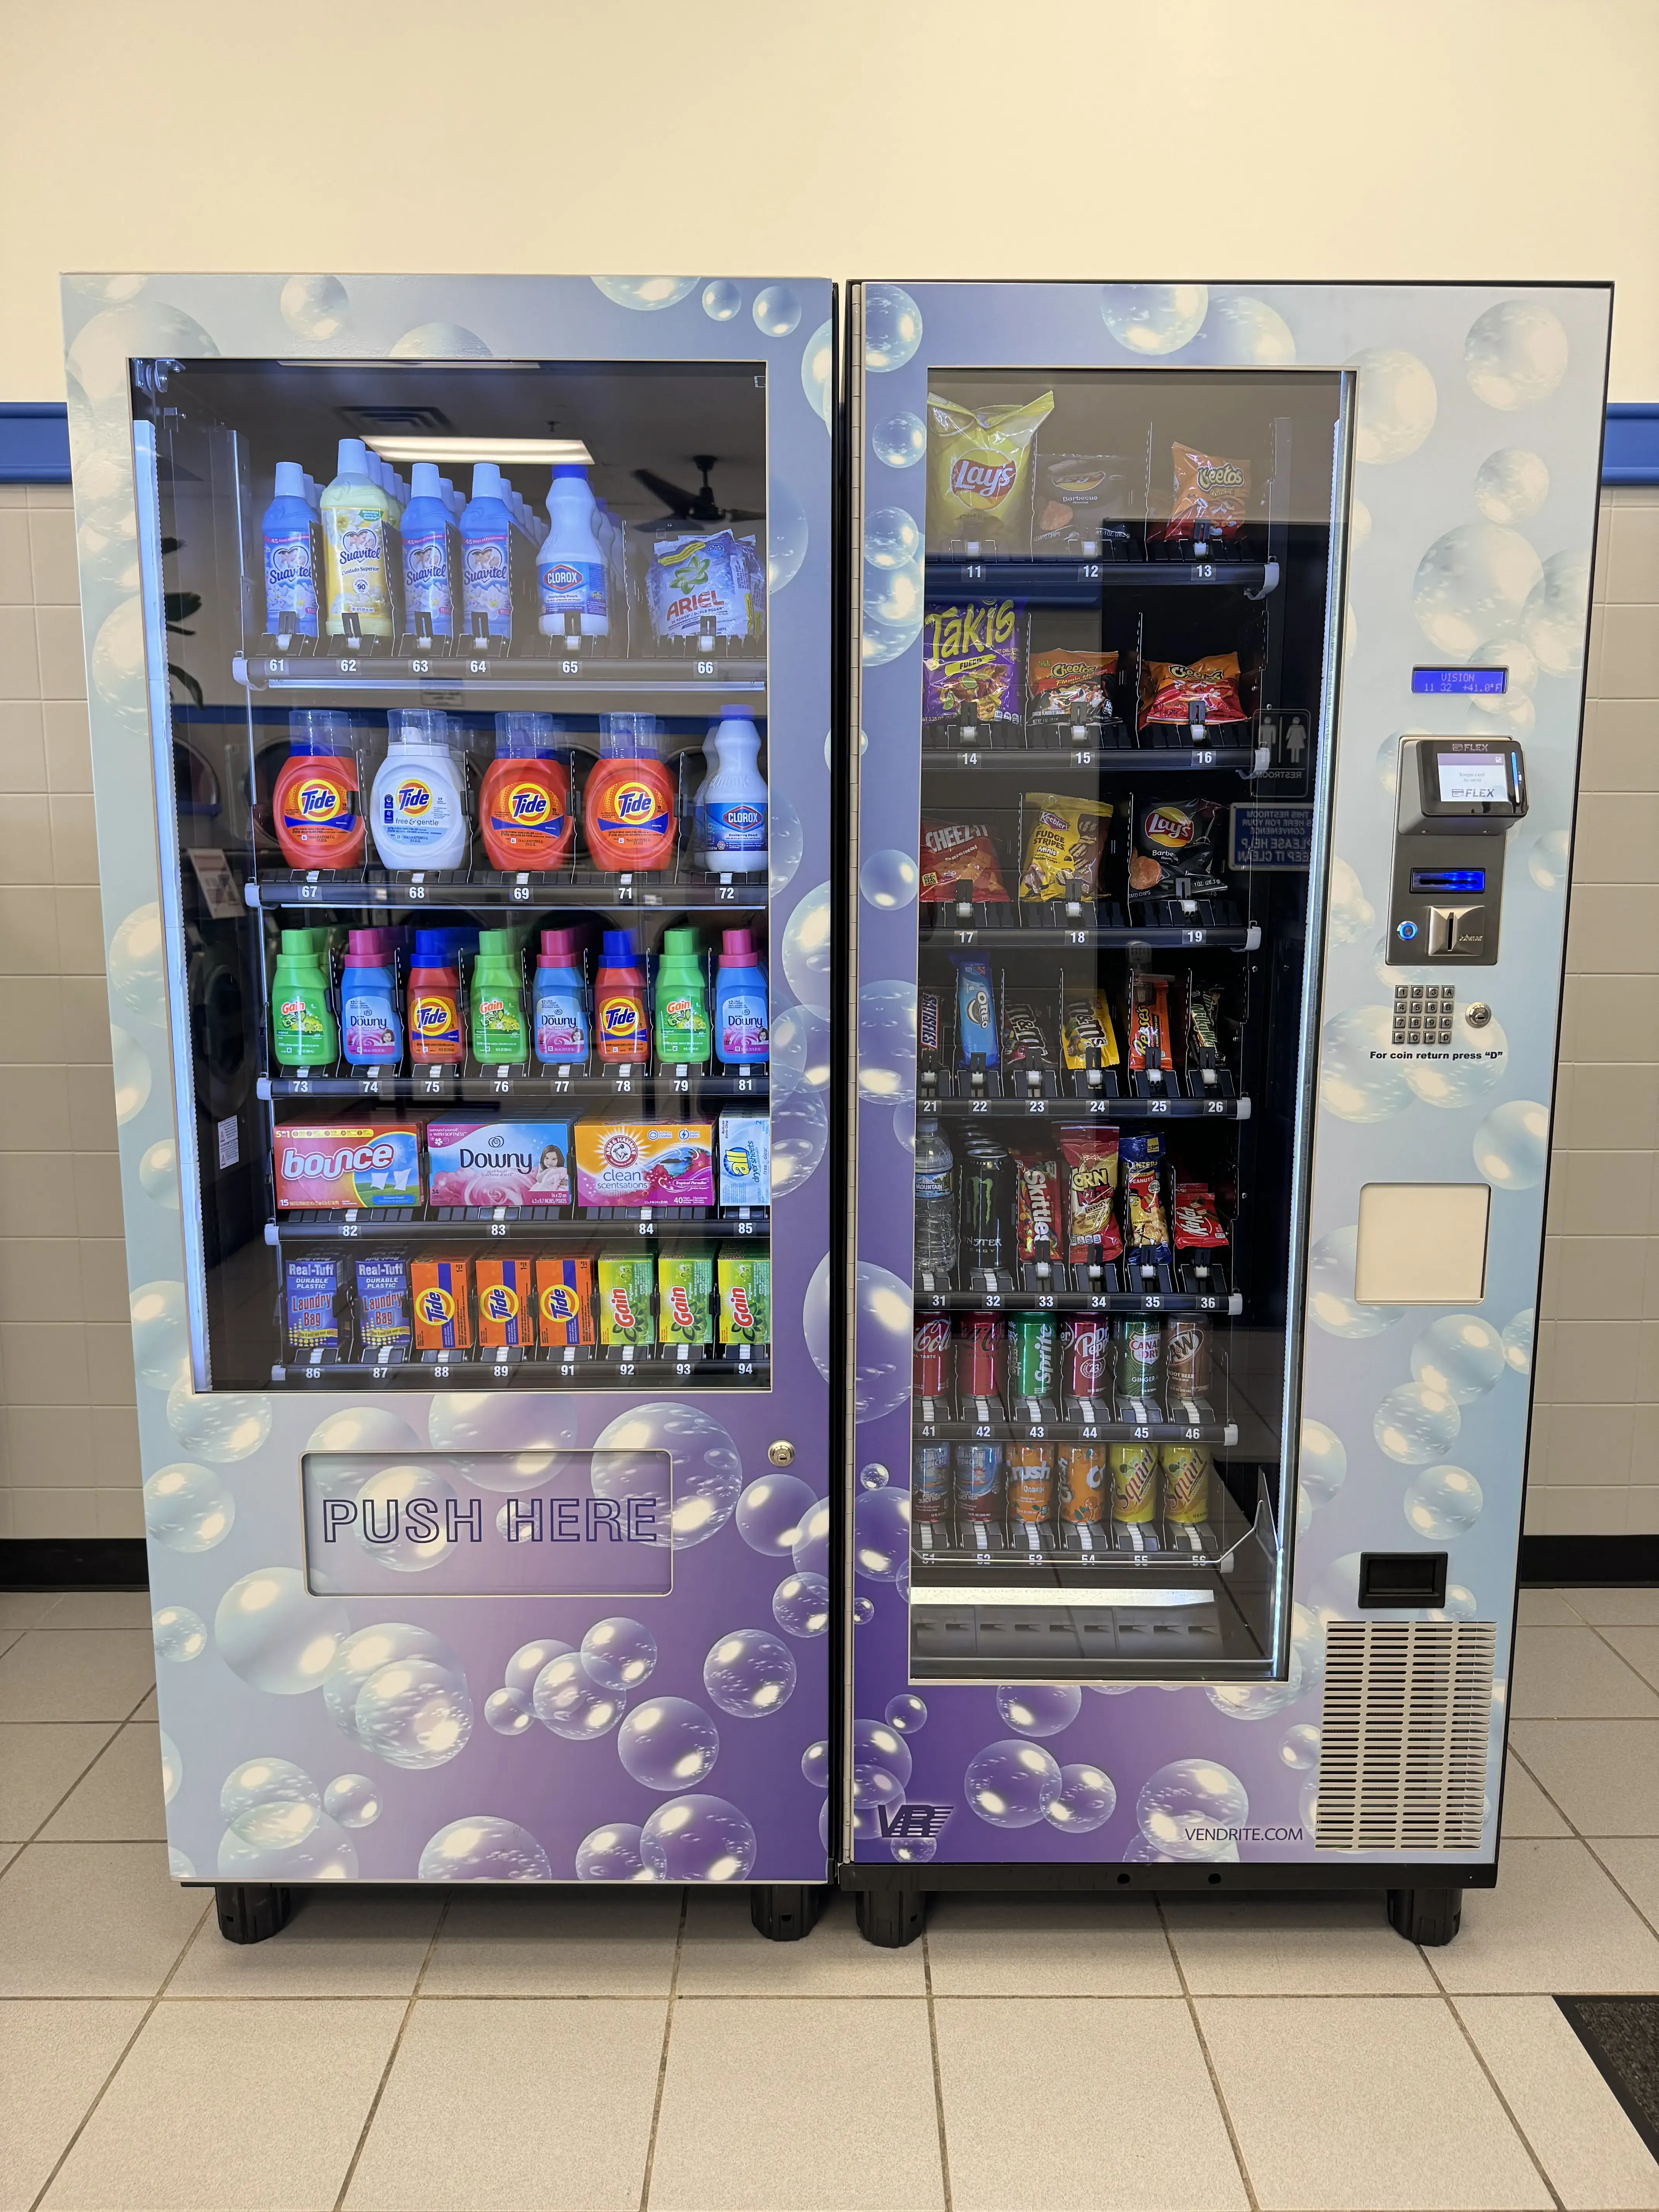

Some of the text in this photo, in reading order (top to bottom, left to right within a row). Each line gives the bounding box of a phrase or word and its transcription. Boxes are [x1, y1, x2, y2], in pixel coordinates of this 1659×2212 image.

[955, 460, 1013, 497] Lay's
[340, 548, 381, 564] Suavitel
[407, 564, 446, 586] Suavitel
[464, 566, 507, 585] Suavitel
[967, 565, 981, 578] 11
[1083, 565, 1099, 577] 12
[1197, 565, 1212, 577] 13
[547, 572, 577, 584] CLOROX
[666, 590, 725, 622] ARIEL
[925, 599, 1015, 660] Takis
[270, 659, 284, 672] 61
[341, 659, 356, 672] 62
[412, 660, 428, 672] 63
[471, 660, 486, 673] 64
[562, 661, 578, 673] 65
[697, 661, 713, 674] 66
[1053, 663, 1097, 678] Cheetos
[1441, 673, 1475, 682] VISION
[1440, 684, 1452, 692] 32
[1464, 744, 1489, 752] FLEX
[962, 753, 977, 764] 14
[1076, 752, 1091, 764] 15
[1197, 751, 1212, 763] 16
[1465, 789, 1494, 797] FLEX
[301, 790, 336, 814] Tide
[398, 788, 429, 811] Tide
[512, 794, 547, 817] Tide
[618, 793, 651, 817] Tide
[728, 812, 758, 823] CLOROX
[1041, 812, 1067, 830] Keebler
[1149, 813, 1191, 839] Lay's
[1035, 830, 1065, 843] FUDGE
[1033, 838, 1065, 851] STRIPES
[1038, 846, 1057, 856] Minis
[302, 886, 318, 898] 67
[409, 886, 424, 898] 68
[514, 888, 529, 900] 69
[618, 887, 632, 899] 71
[719, 887, 734, 899] 72
[959, 931, 973, 943] 17
[1070, 931, 1085, 943] 18
[1187, 931, 1202, 942] 19
[480, 1001, 503, 1013] Gain
[667, 1000, 690, 1013] Gain
[976, 991, 988, 1029] OREO
[350, 1016, 387, 1029] Downy
[417, 1008, 447, 1029] Tide
[541, 1015, 576, 1028] Downy
[605, 1008, 635, 1029] Tide
[728, 1015, 763, 1029] Downy
[293, 1081, 308, 1092] 73
[362, 1080, 378, 1092] 74
[425, 1081, 440, 1092] 75
[494, 1081, 509, 1092] 76
[555, 1081, 569, 1092] 77
[616, 1080, 630, 1092] 78
[673, 1080, 688, 1091] 79
[738, 1079, 752, 1091] 81
[924, 1100, 937, 1112] 21
[973, 1100, 987, 1112] 22
[1030, 1100, 1044, 1112] 23
[1090, 1101, 1105, 1112] 24
[1152, 1100, 1167, 1112] 25
[1208, 1101, 1223, 1112] 26
[605, 1142, 613, 1156] ARM
[617, 1137, 637, 1155] HAMMER
[747, 1140, 756, 1163] sheets
[283, 1145, 393, 1179] bounce
[460, 1148, 533, 1175] Downy
[725, 1149, 750, 1175] all
[603, 1169, 641, 1181] clean
[343, 1225, 358, 1237] 82
[491, 1224, 506, 1235] 83
[639, 1223, 654, 1235] 84
[738, 1223, 752, 1234] 85
[289, 1263, 334, 1276] Real-Tuff
[359, 1263, 403, 1275] Real-Tuff
[292, 1293, 332, 1312] Laundry
[363, 1292, 402, 1312] Laundry
[426, 1291, 448, 1322] Tide
[489, 1288, 514, 1319] Tide
[550, 1288, 574, 1319] Tide
[671, 1286, 694, 1326] Gain
[933, 1295, 945, 1306] 31
[986, 1295, 1000, 1306] 32
[1039, 1296, 1053, 1307] 33
[1092, 1296, 1106, 1307] 34
[1146, 1296, 1160, 1307] 35
[1201, 1297, 1215, 1308] 36
[611, 1288, 635, 1327] Gain
[730, 1287, 753, 1327] Gain
[303, 1312, 321, 1327] Bag
[375, 1311, 392, 1326] Bag
[1034, 1325, 1054, 1384] Sprite
[1142, 1350, 1159, 1358] DRY
[306, 1368, 320, 1378] 86
[373, 1367, 388, 1378] 87
[434, 1366, 449, 1377] 88
[494, 1365, 508, 1377] 89
[561, 1365, 574, 1376] 91
[620, 1364, 634, 1375] 92
[676, 1364, 690, 1374] 93
[738, 1363, 753, 1374] 94
[1089, 1363, 1100, 1372] 23
[922, 1425, 935, 1436] 41
[976, 1426, 991, 1437] 42
[1030, 1426, 1044, 1437] 43
[1083, 1427, 1097, 1438] 44
[1134, 1427, 1149, 1438] 45
[1185, 1428, 1200, 1439] 46
[1115, 1447, 1154, 1510] Squirt
[1165, 1448, 1204, 1510] Squirt
[323, 1498, 657, 1543] PUSH HERE
[1185, 1827, 1304, 1841] VENDRITE.COM
